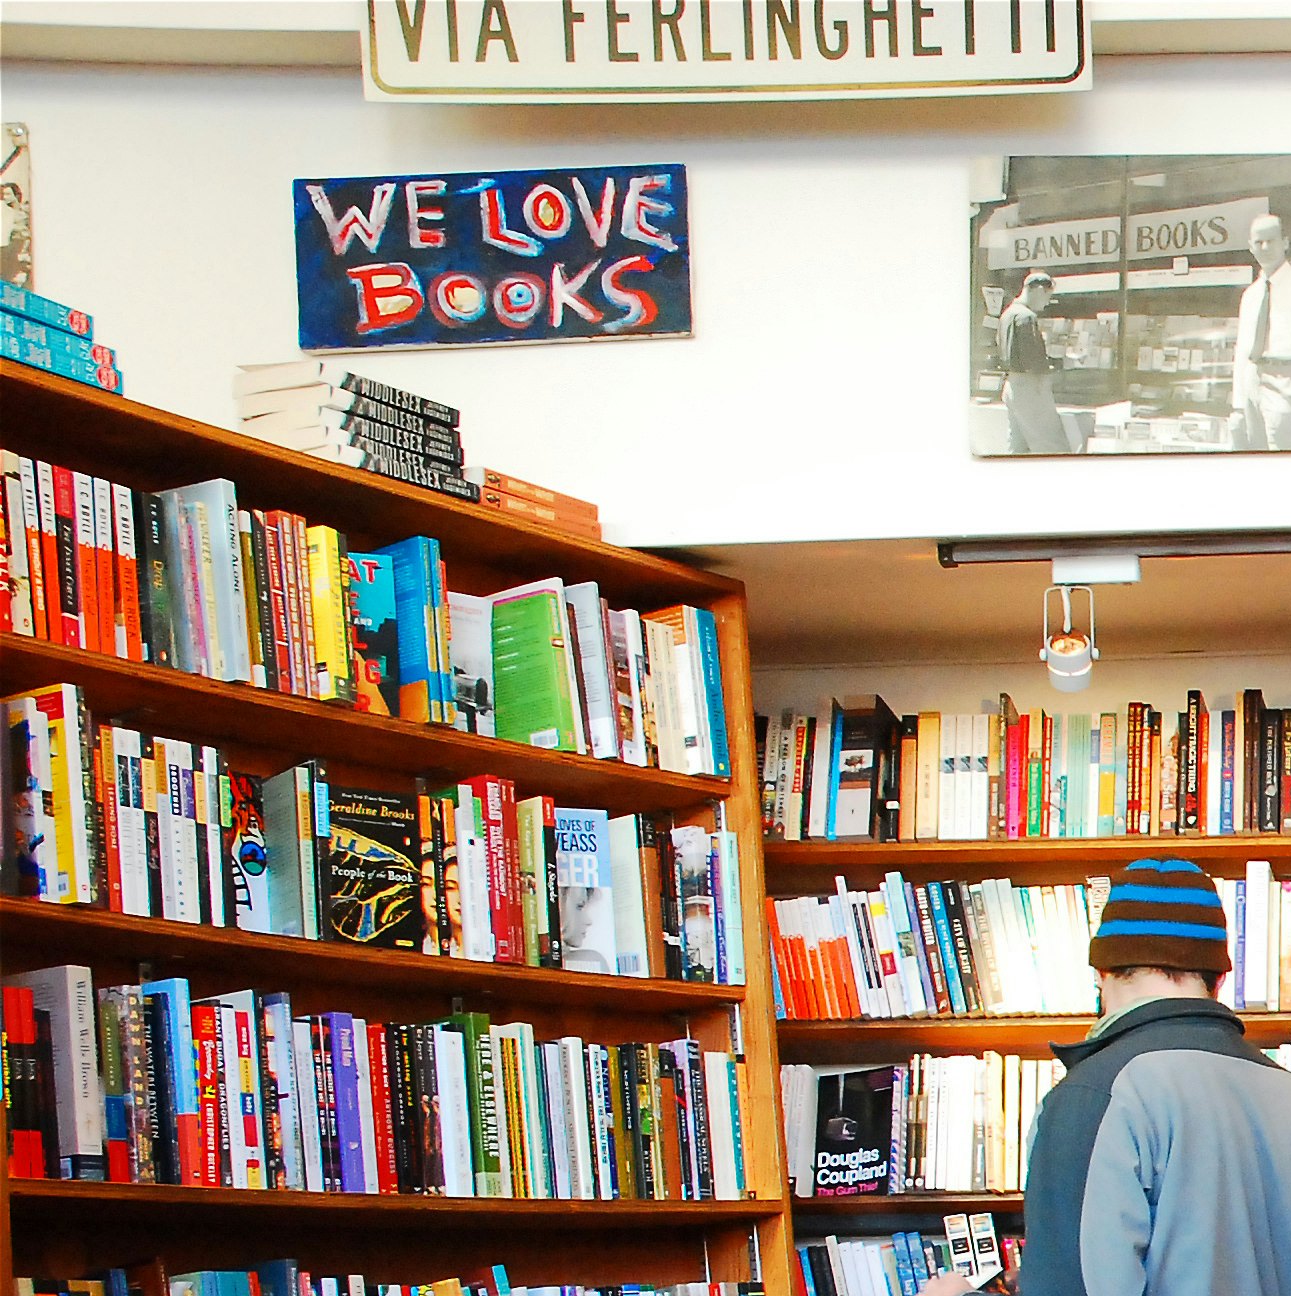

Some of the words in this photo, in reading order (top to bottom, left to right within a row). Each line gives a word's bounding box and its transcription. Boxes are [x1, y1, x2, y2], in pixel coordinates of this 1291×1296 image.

[394, 0, 520, 62] VIA
[305, 179, 448, 256] WE
[462, 174, 680, 258] LOVE
[1014, 230, 1121, 262] BANNED
[1136, 215, 1230, 253] BOOKS
[346, 255, 660, 336] BOOKS
[360, 378, 421, 413] MIDDLESEX
[368, 400, 424, 436] MIDDLESEX
[361, 421, 423, 454] MIDDLESEX
[380, 457, 441, 491] MIDDLESEX
[226, 502, 238, 550] ACTING
[231, 553, 241, 594] ALONE
[328, 798, 378, 817] Geraldine
[380, 803, 415, 821] Brooks
[585, 818, 595, 832] OF
[331, 864, 366, 880] People
[388, 870, 413, 884] Book
[479, 1033, 491, 1068] HERE
[483, 1083, 500, 1158] ELSEWHERE
[816, 1146, 880, 1170] Douglas
[816, 1160, 888, 1186] Coupland
[817, 1186, 835, 1198] The
[836, 1184, 857, 1196] Gum
[858, 1181, 879, 1193] Thief
